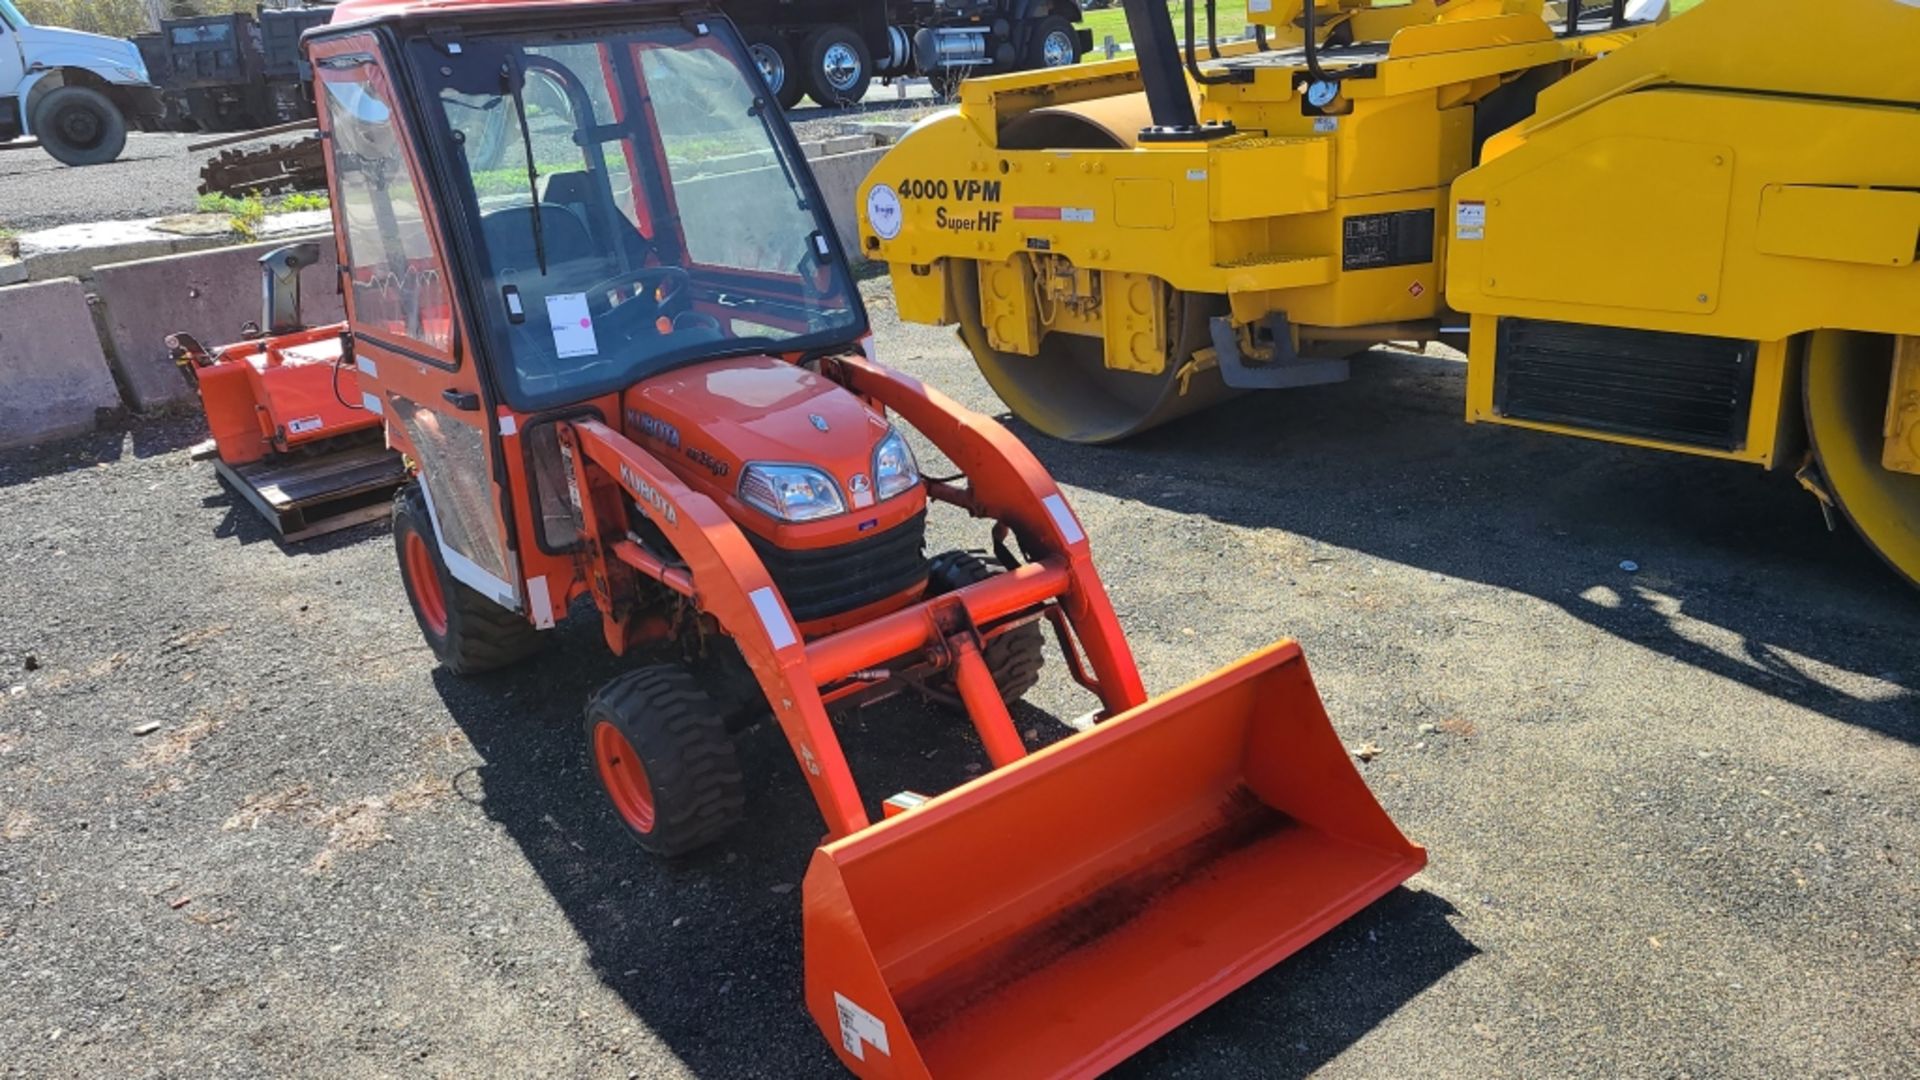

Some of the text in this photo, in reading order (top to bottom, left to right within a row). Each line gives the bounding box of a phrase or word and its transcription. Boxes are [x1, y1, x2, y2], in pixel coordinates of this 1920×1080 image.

[899, 179, 948, 199] 4000
[953, 180, 1002, 202] VPM
[936, 206, 1002, 234] Super HF
[627, 409, 681, 449] KUBOTA
[619, 461, 678, 527] KUBOTA
